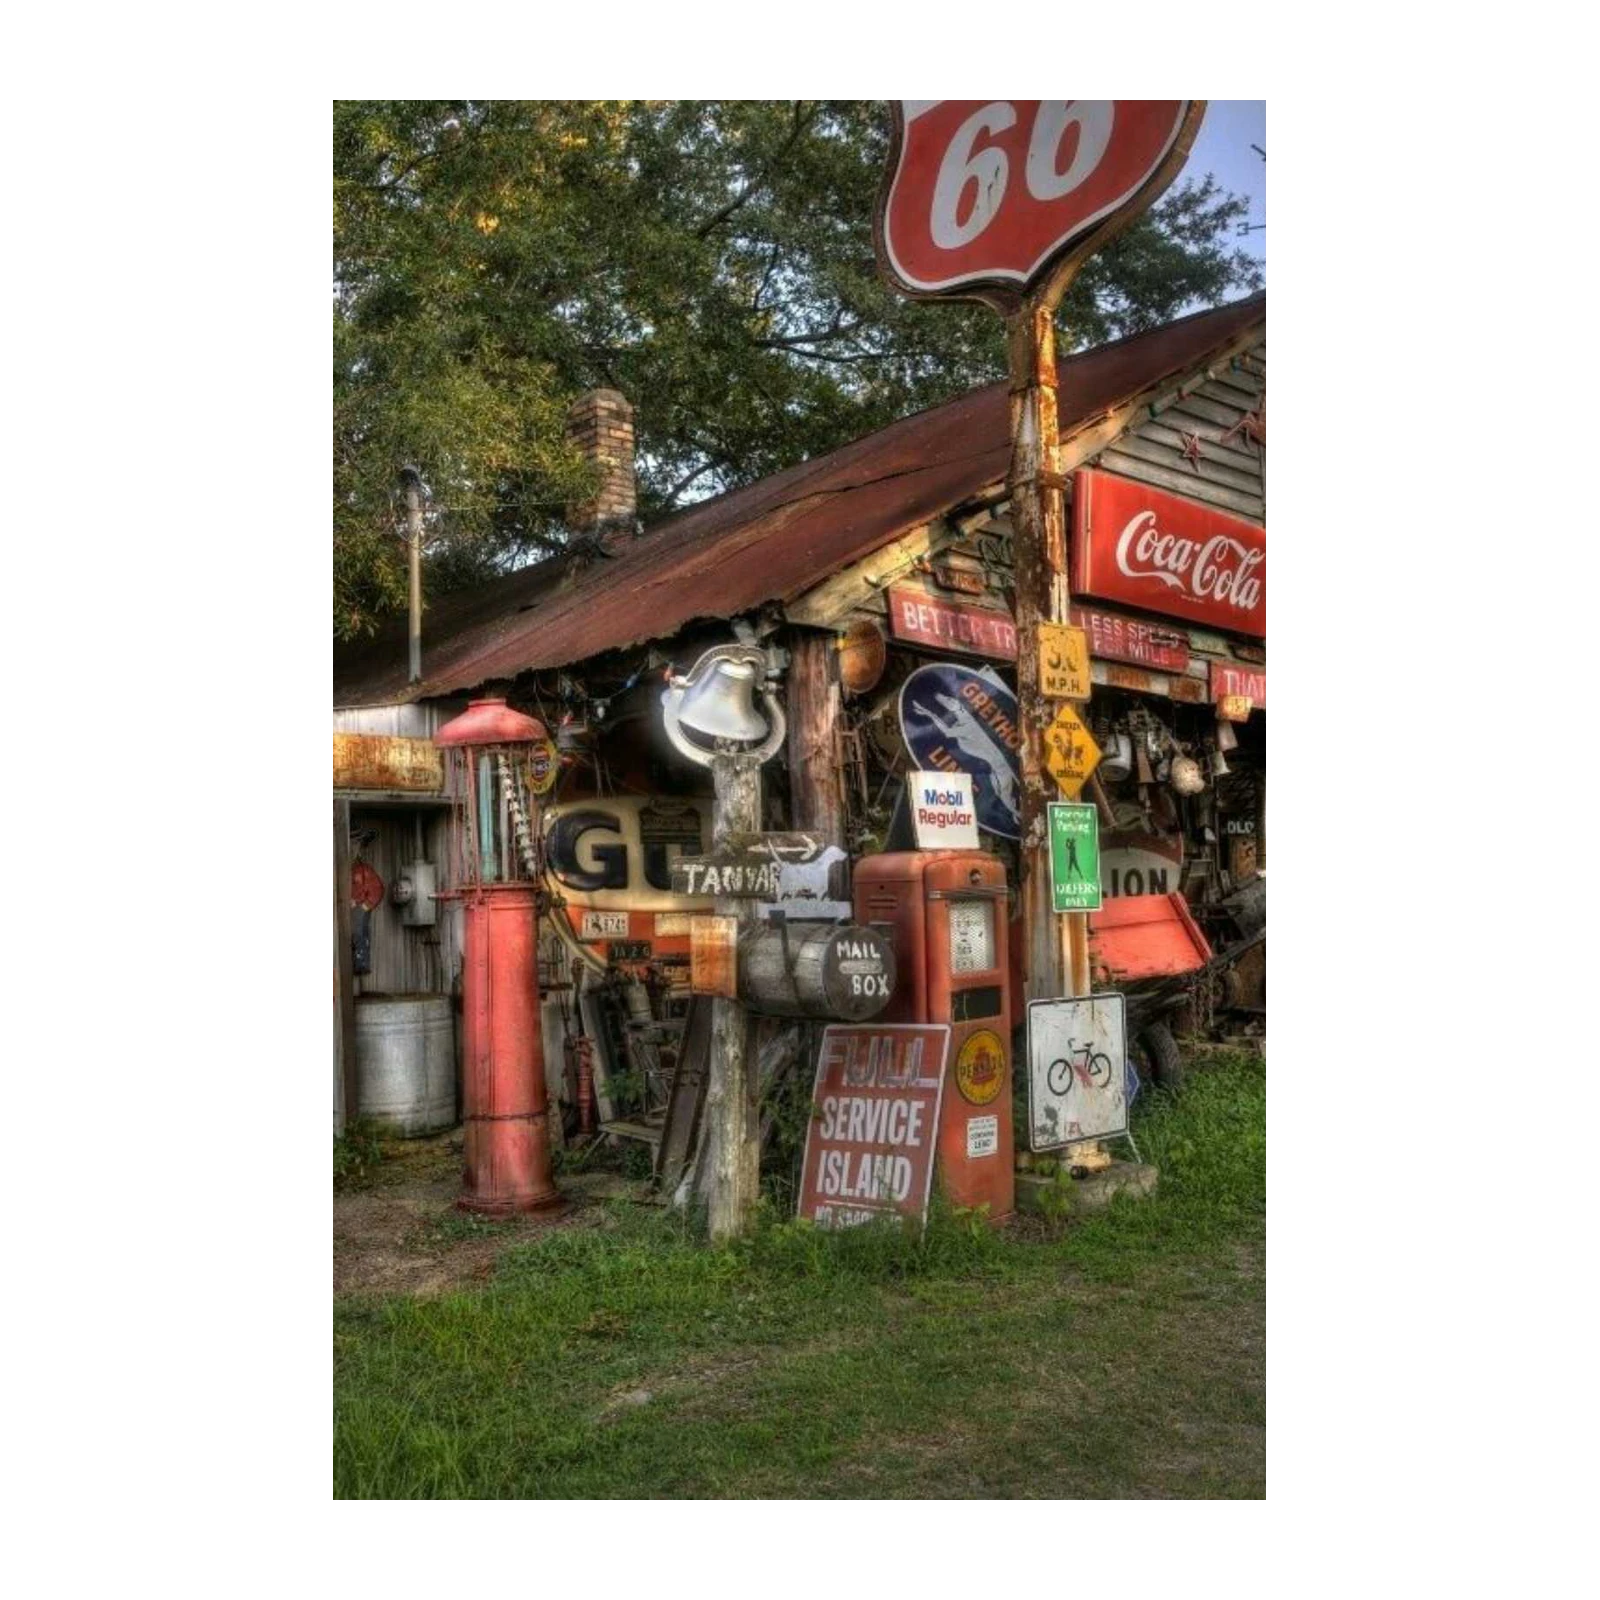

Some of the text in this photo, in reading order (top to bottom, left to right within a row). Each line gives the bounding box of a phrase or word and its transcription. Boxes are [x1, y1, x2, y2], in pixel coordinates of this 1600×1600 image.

[930, 96, 1115, 250] 66
[1116, 510, 1265, 610] Coca-Cola
[989, 619, 1018, 650] TR
[1081, 611, 1122, 637] LESS
[924, 789, 963, 806] Mobil
[918, 808, 972, 830] Regular
[1101, 868, 1167, 899] ION
[837, 940, 881, 958] MAIL
[852, 974, 890, 997] BOX
[816, 1035, 940, 1087] FULL
[820, 1096, 925, 1146] SERVICE
[816, 1150, 911, 1201] ISLAND
